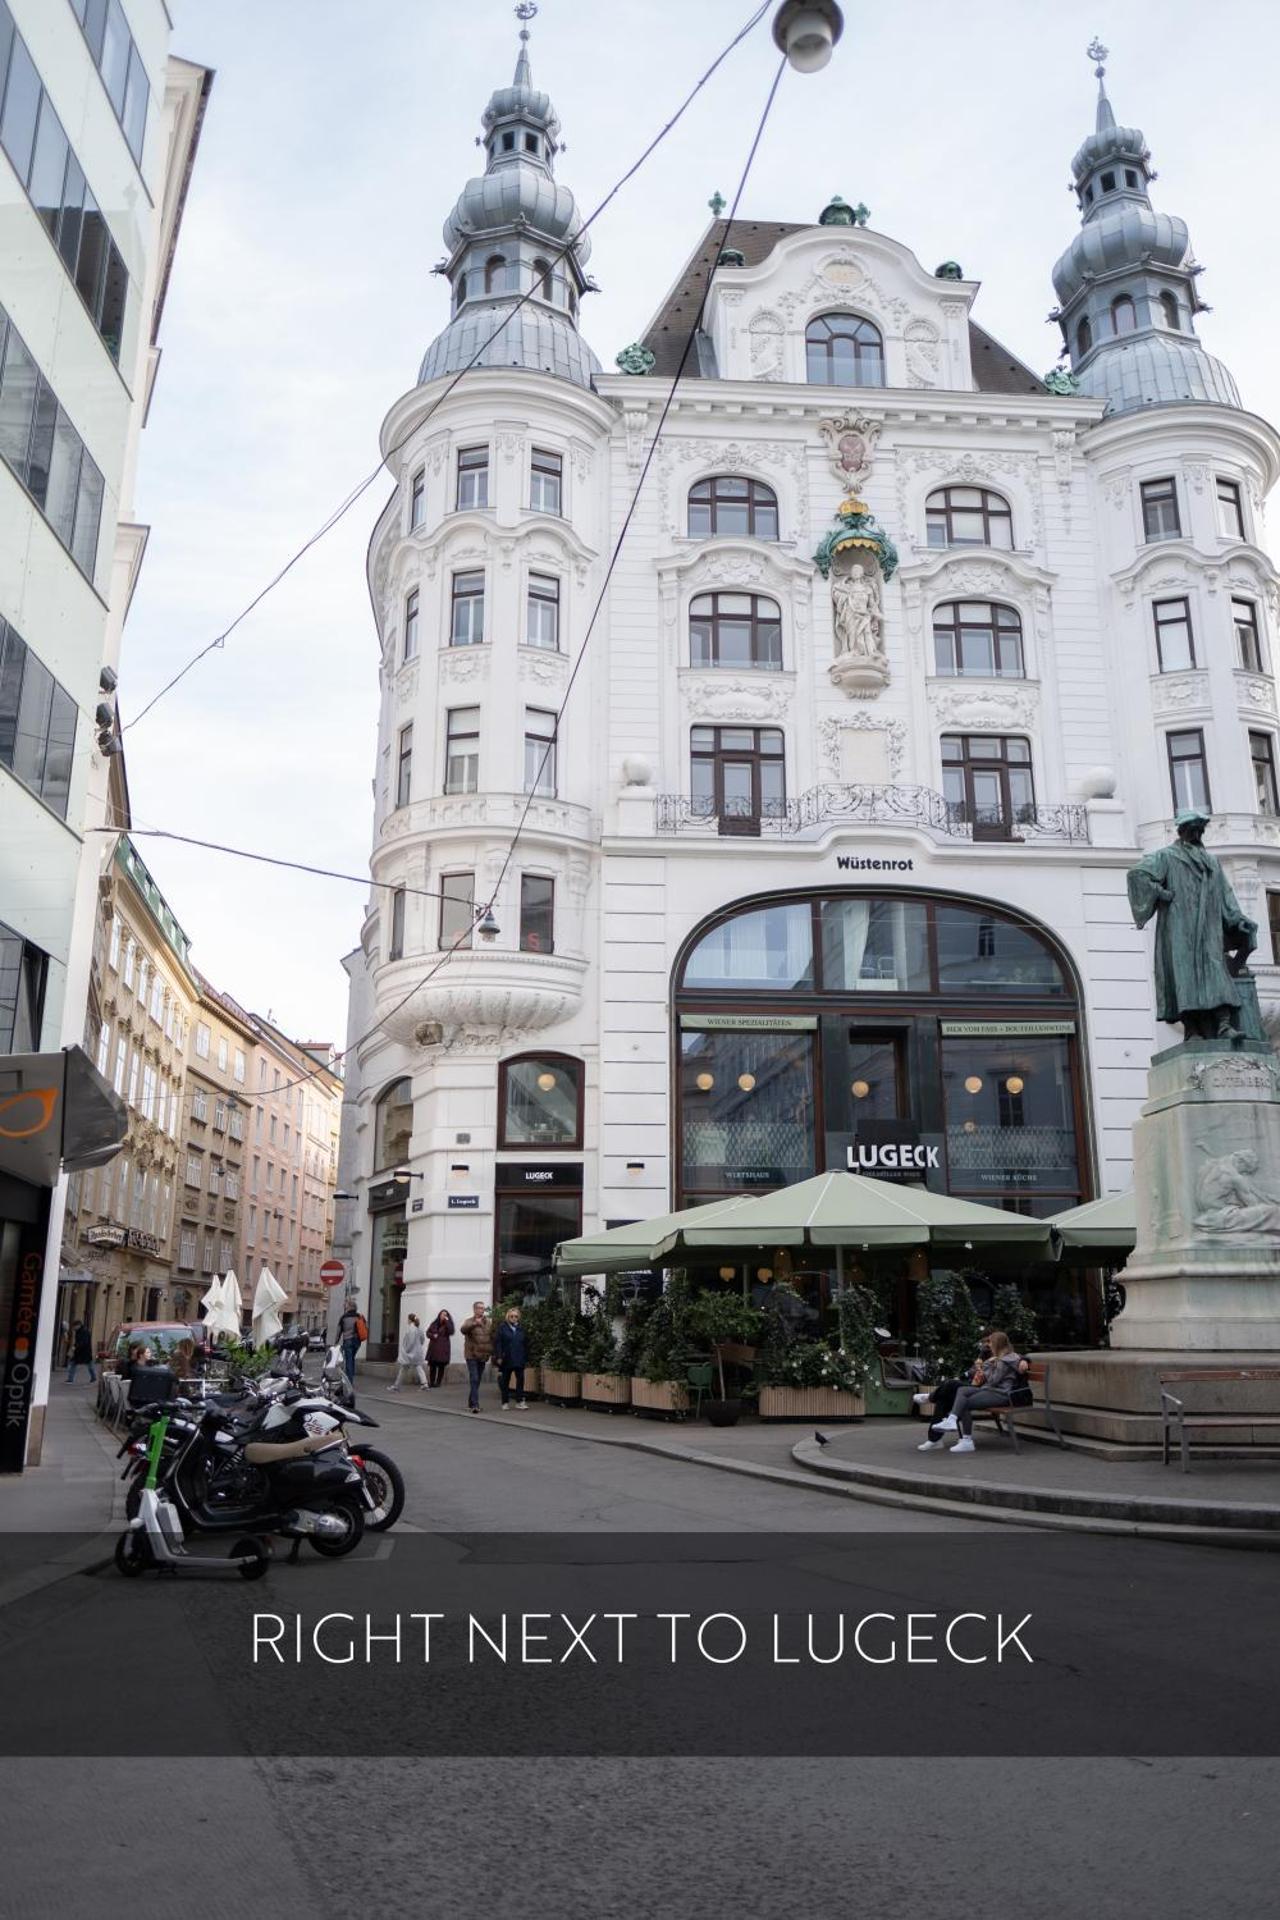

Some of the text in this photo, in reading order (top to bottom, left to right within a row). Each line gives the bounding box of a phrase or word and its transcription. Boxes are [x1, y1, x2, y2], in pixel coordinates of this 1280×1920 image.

[836, 855, 914, 871] Wüstenrot
[707, 1018, 736, 1026] WIENER
[846, 1144, 940, 1168] LUGECK
[525, 1171, 554, 1180] LUGECK
[5, 1363, 31, 1428] Optik
